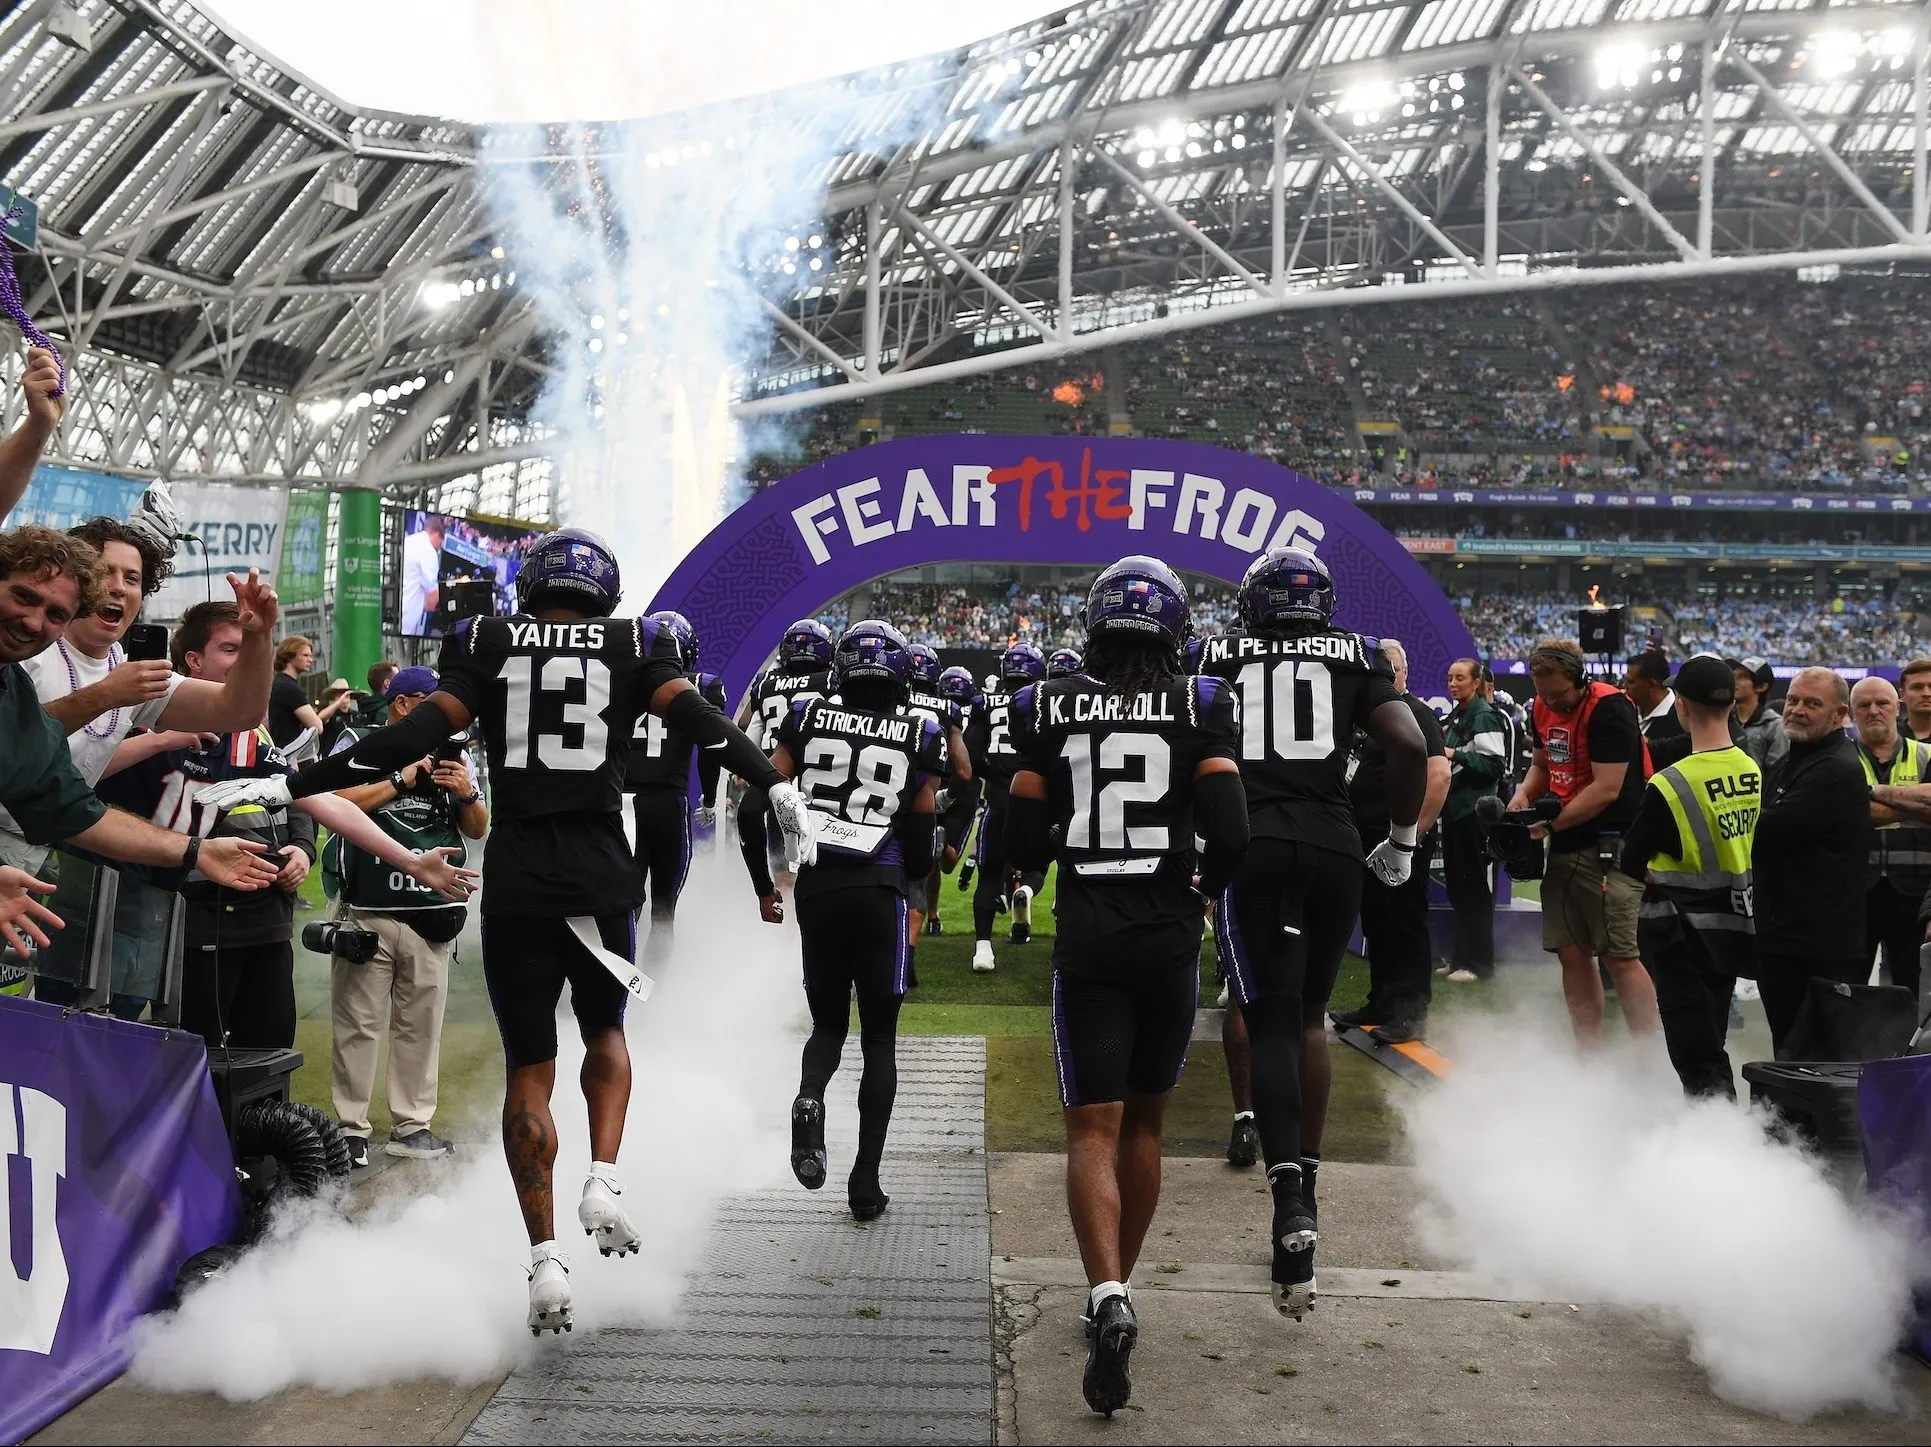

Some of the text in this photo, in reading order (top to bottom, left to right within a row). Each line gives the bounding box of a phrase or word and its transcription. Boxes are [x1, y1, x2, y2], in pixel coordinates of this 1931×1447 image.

[791, 465, 997, 566] FEAR
[987, 447, 1134, 532] THE
[181, 522, 278, 556] KERRY
[507, 622, 604, 648] YAITES
[1211, 640, 1233, 663] M.
[774, 675, 810, 691] MAYS
[497, 656, 611, 771] 13
[909, 692, 947, 711] ADDEN
[988, 695, 1011, 707] TEA
[1050, 694, 1070, 725] K.
[1235, 661, 1335, 760] 10
[814, 708, 910, 743] STRICKLAND
[801, 736, 910, 826] 28
[1060, 732, 1171, 850] 12
[1704, 772, 1760, 803] PULSE
[1718, 807, 1759, 841] SECURIT
